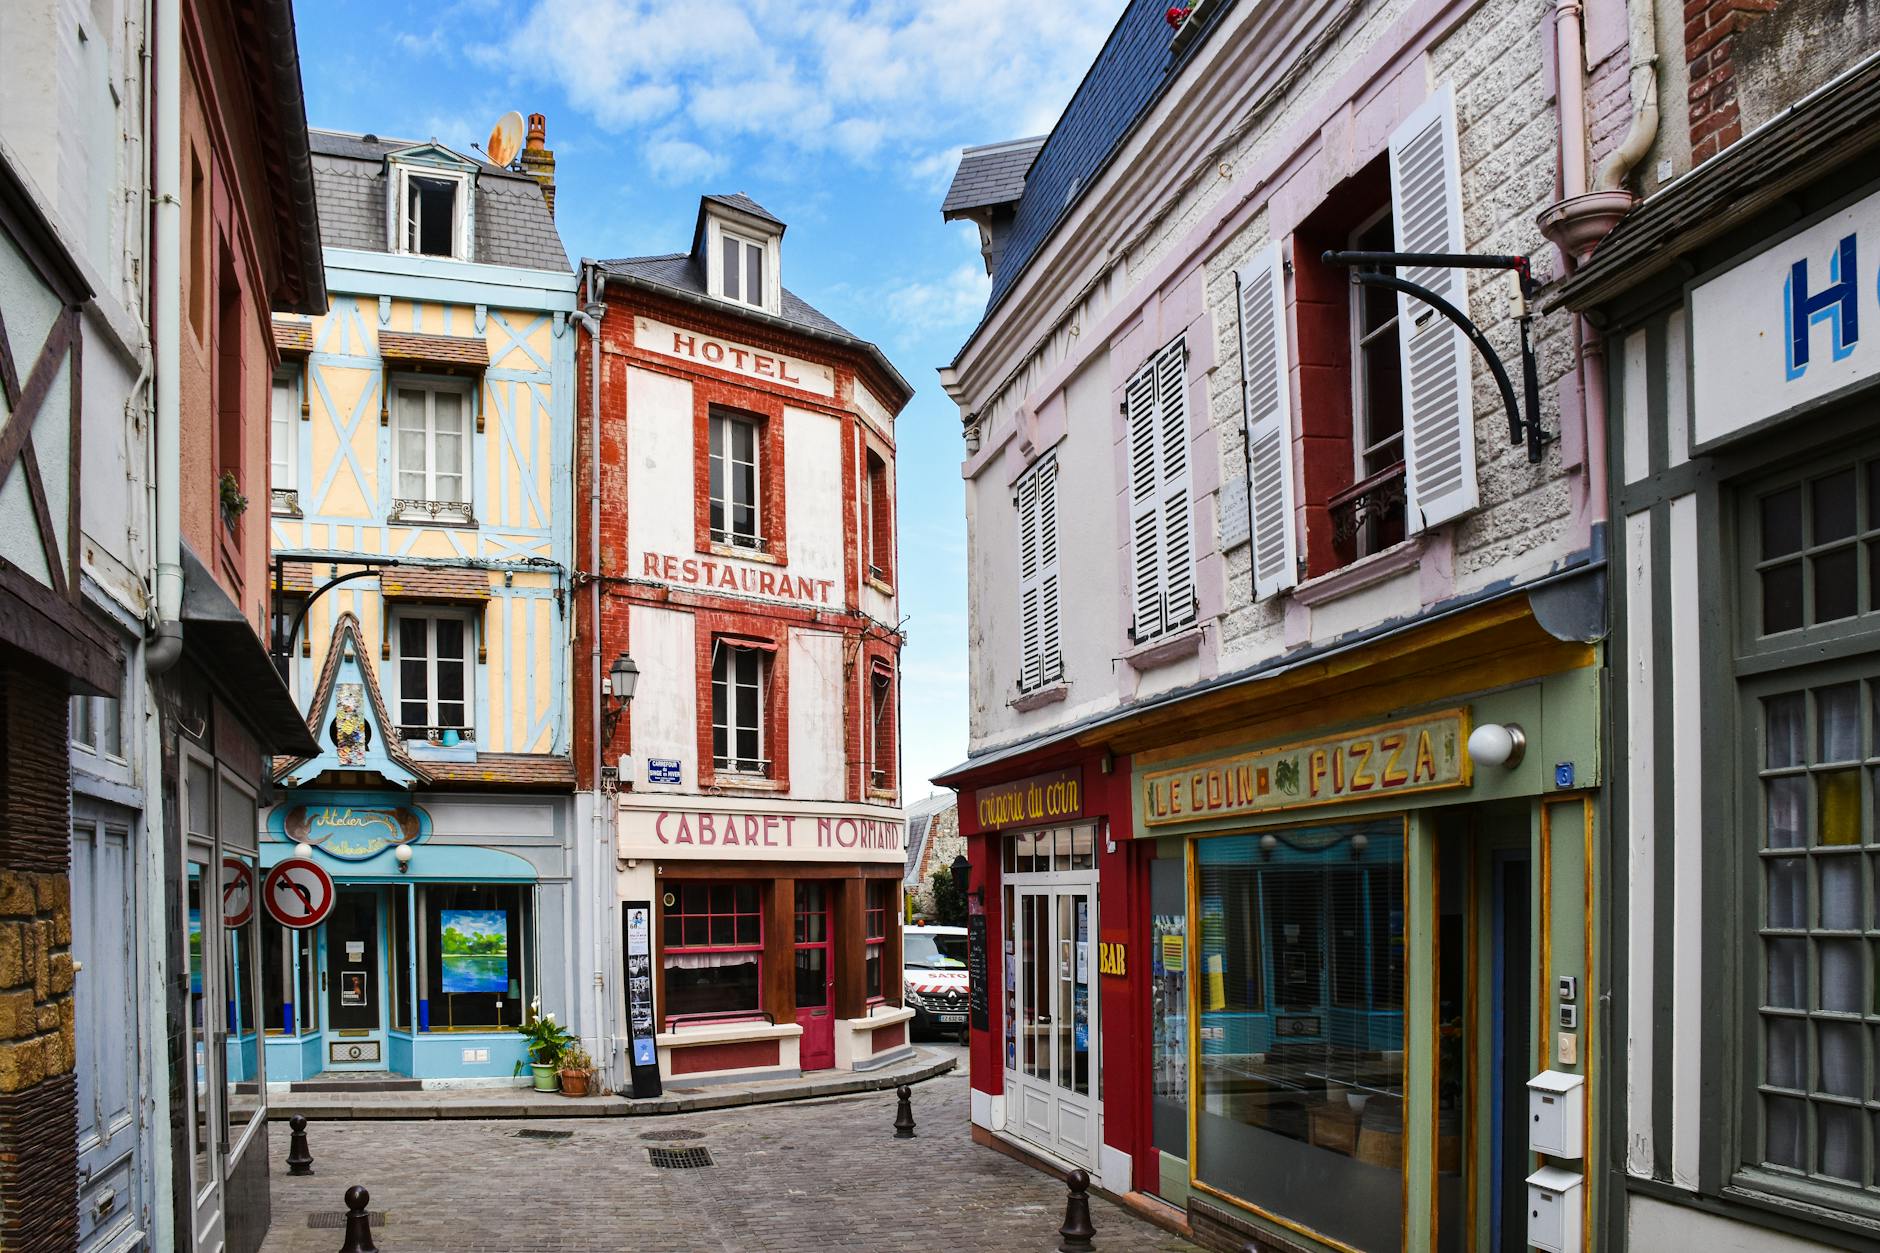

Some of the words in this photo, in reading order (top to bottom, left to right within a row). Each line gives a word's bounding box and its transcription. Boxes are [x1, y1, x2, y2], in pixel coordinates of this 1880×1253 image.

[1784, 232, 1880, 383] H
[673, 332, 800, 384] HOTEL
[643, 551, 835, 603] RESTAURANT
[1155, 775, 1182, 817] LE
[1190, 765, 1254, 812] COIN
[1309, 729, 1436, 798] PIZZA
[317, 806, 364, 827] Atelier
[980, 785, 1025, 830] crêperie
[1028, 782, 1044, 818] du
[1046, 774, 1079, 815] coin
[655, 811, 796, 846] CABARET
[817, 817, 899, 850] NORMAND
[658, 866, 662, 874] 2
[1099, 943, 1126, 976] BAR
